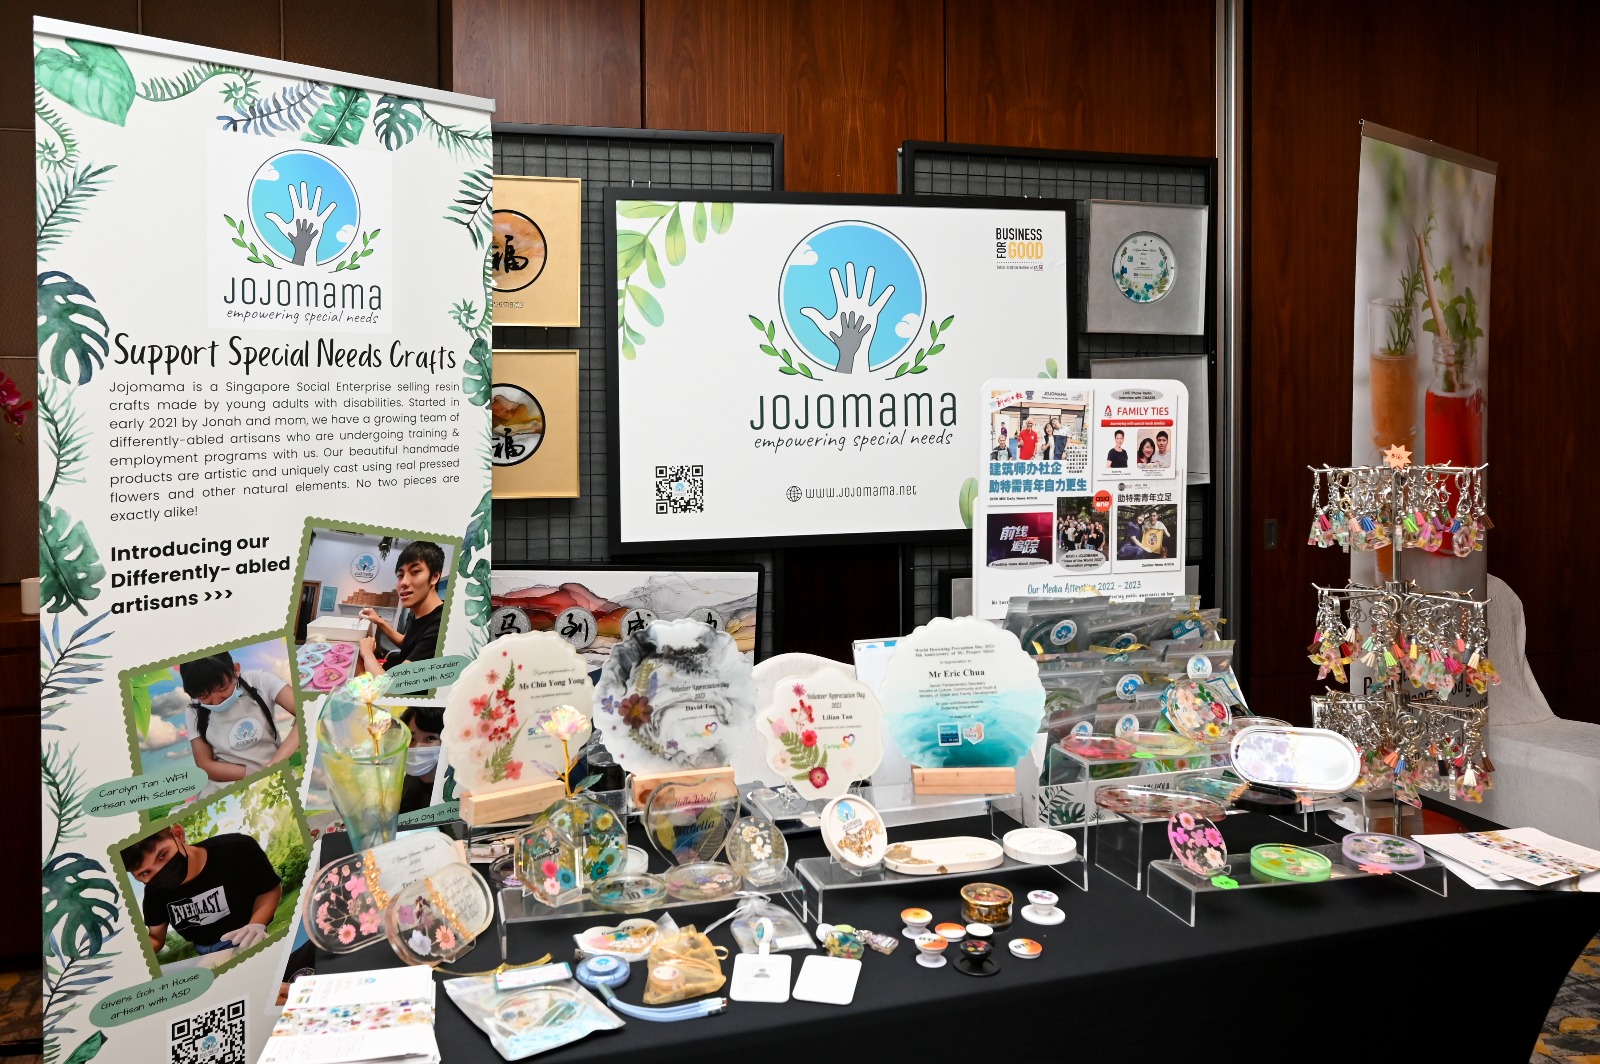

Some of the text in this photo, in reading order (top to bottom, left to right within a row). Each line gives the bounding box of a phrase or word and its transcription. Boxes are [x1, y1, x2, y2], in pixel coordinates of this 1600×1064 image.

[996, 228, 1042, 240] BUSINESS
[996, 242, 1044, 260] FOR GOOD
[227, 308, 378, 325] empowering special needs
[114, 332, 456, 376] Support Special Needs Crafts
[109, 381, 460, 396] Jojomama is a Singapore Social Enterprise selling resin
[109, 397, 460, 413] crafts made by young adults with disabilities. Started in
[1117, 407, 1169, 416] FAMILY TIES
[109, 412, 460, 432] early 2021 by Jonah and mom, we have a growing team of
[109, 427, 460, 449] differently-abled artisans who are undergoing training &
[754, 428, 953, 454] empowering special needs
[109, 443, 460, 469] employment programs with us. Our beautiful handmade
[110, 458, 460, 488] products are artistic and uniquely cast using real pressed
[110, 475, 460, 504] flowers and other natural elements. No two pieces are
[989, 478, 1088, 493] 助特需青年自力更生
[110, 505, 198, 522] exactly alike!
[1000, 526, 1029, 540] 前线
[110, 534, 270, 562] Introducing our
[1010, 540, 1040, 554] 追踪
[110, 556, 290, 588] Differently- abled
[1028, 580, 1142, 594] Our Media 2022 2023
[110, 592, 199, 616] artisans
[391, 668, 410, 678] Jonah
[396, 679, 420, 688] artisan
[440, 672, 454, 680] ASD
[944, 670, 960, 678] Eric
[963, 668, 984, 676] Chua
[548, 680, 566, 688] Yong
[686, 704, 702, 712] David
[90, 784, 196, 812] artisan with Sclerosis
[99, 784, 138, 798] Carolyn
[694, 791, 718, 803] World
[170, 890, 222, 926] EVERLAST
[136, 988, 154, 999] Goh
[172, 974, 200, 987] House
[110, 988, 191, 1020] artisan with ASD
